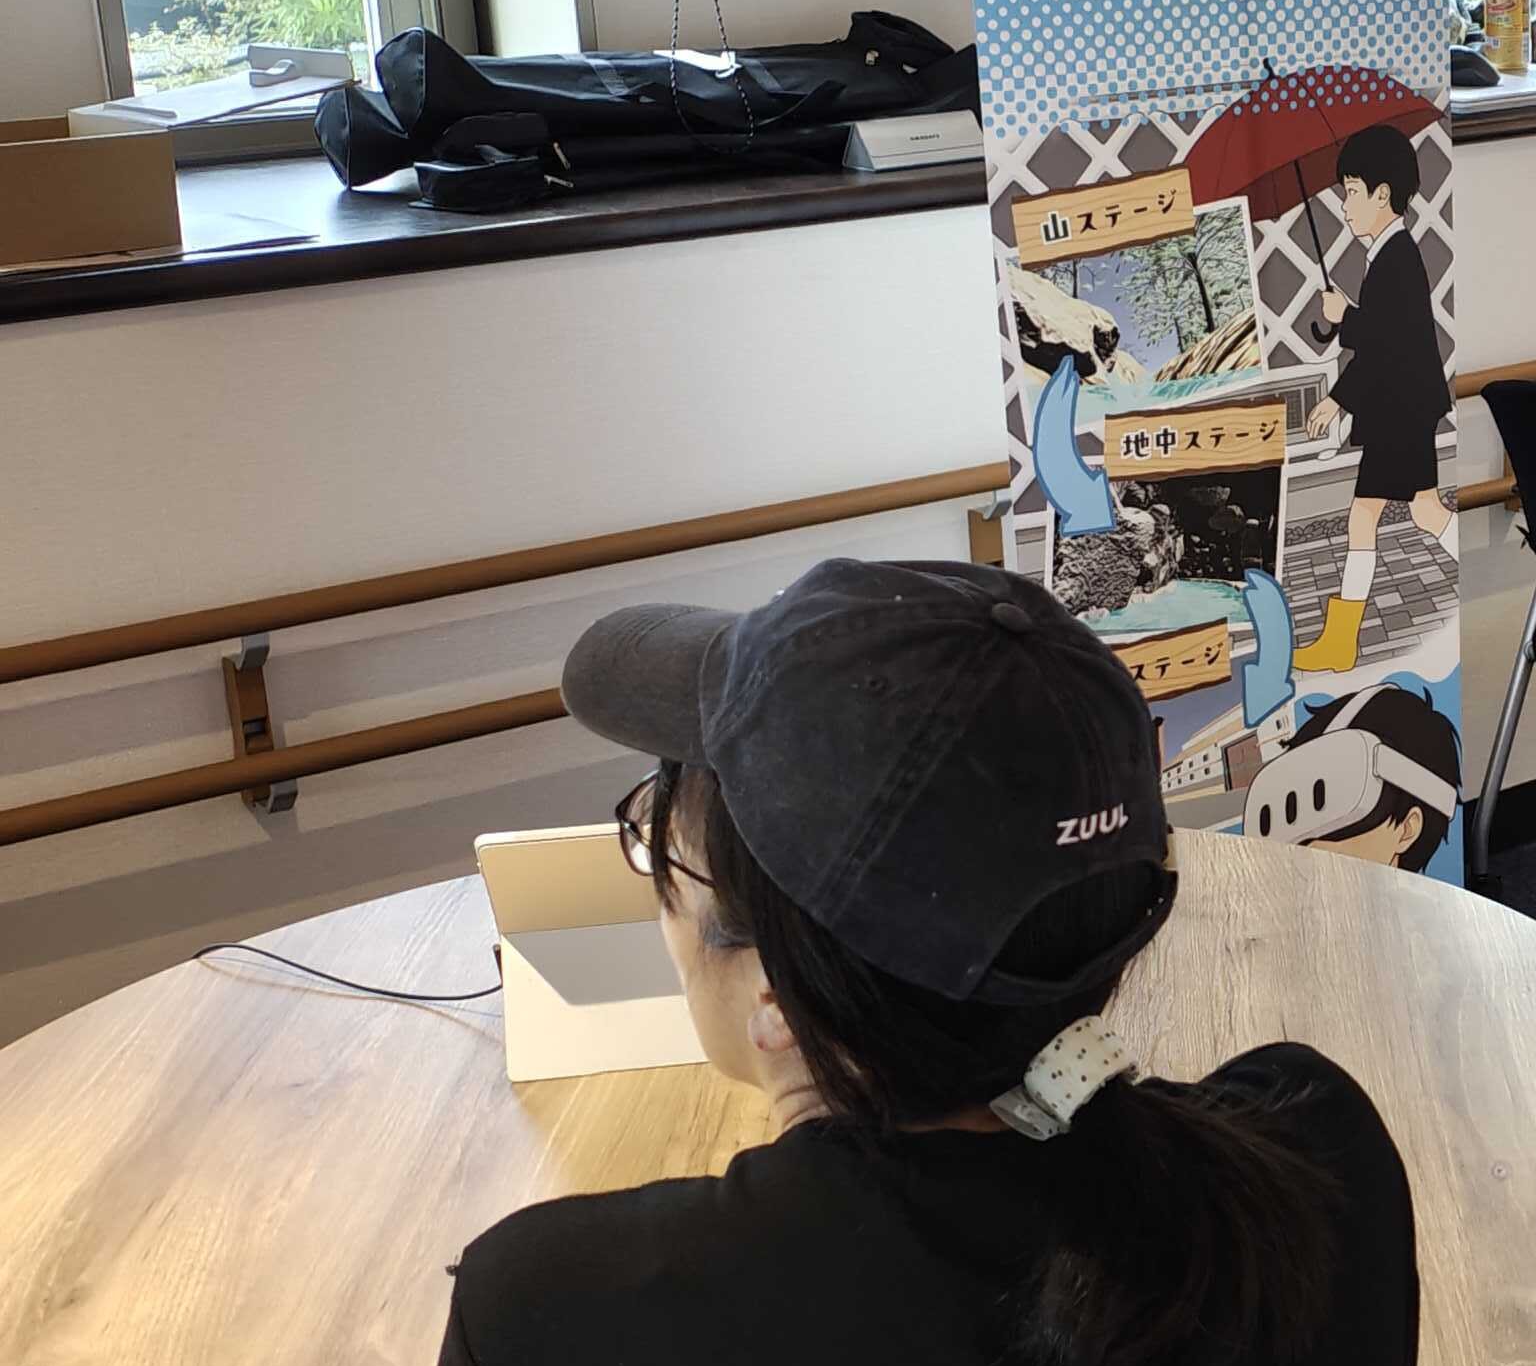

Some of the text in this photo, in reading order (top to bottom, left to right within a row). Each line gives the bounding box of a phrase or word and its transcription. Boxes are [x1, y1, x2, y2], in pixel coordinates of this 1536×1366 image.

[1041, 188, 1177, 244] 山ステージ
[1122, 419, 1279, 458] 地中ステージ
